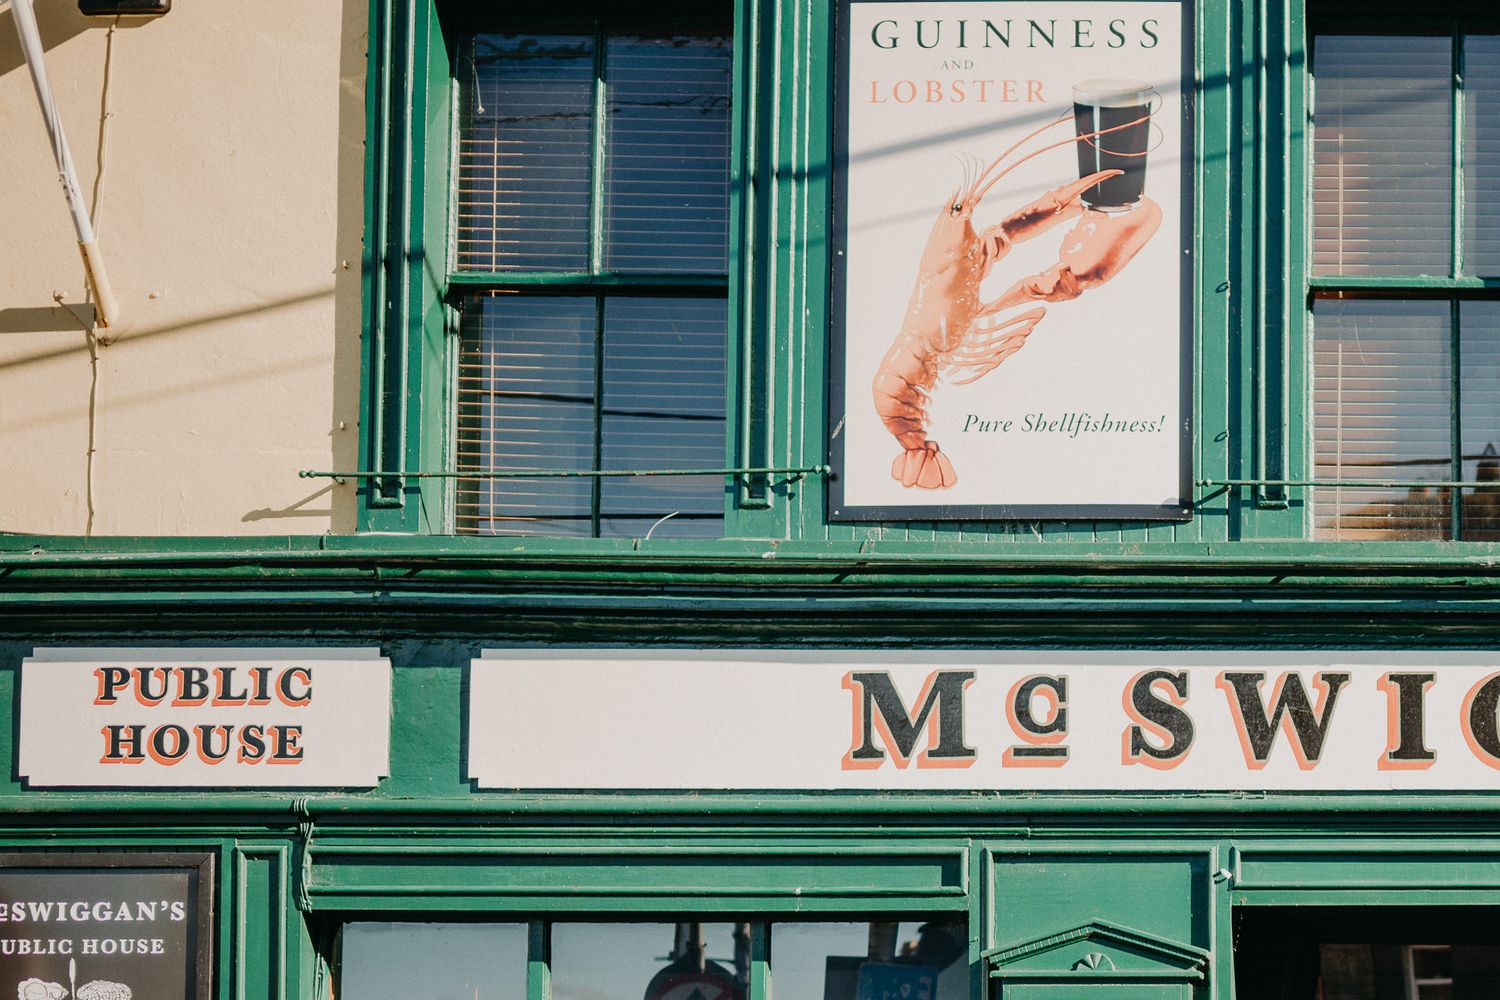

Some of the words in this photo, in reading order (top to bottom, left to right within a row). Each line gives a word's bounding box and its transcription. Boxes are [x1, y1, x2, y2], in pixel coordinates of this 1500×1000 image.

[871, 19, 1161, 50] GUINNESS
[940, 59, 975, 71] AND
[869, 79, 1047, 104] LOBSTER
[962, 413, 1014, 434] Pure
[1020, 411, 1167, 438] Shellfishness!
[93, 667, 313, 708] PUBLIC
[99, 724, 304, 767] HOUSE
[0, 900, 186, 923] cSWIGGAN'S
[0, 938, 73, 955] UBLIC
[81, 938, 165, 955] HOUSE
